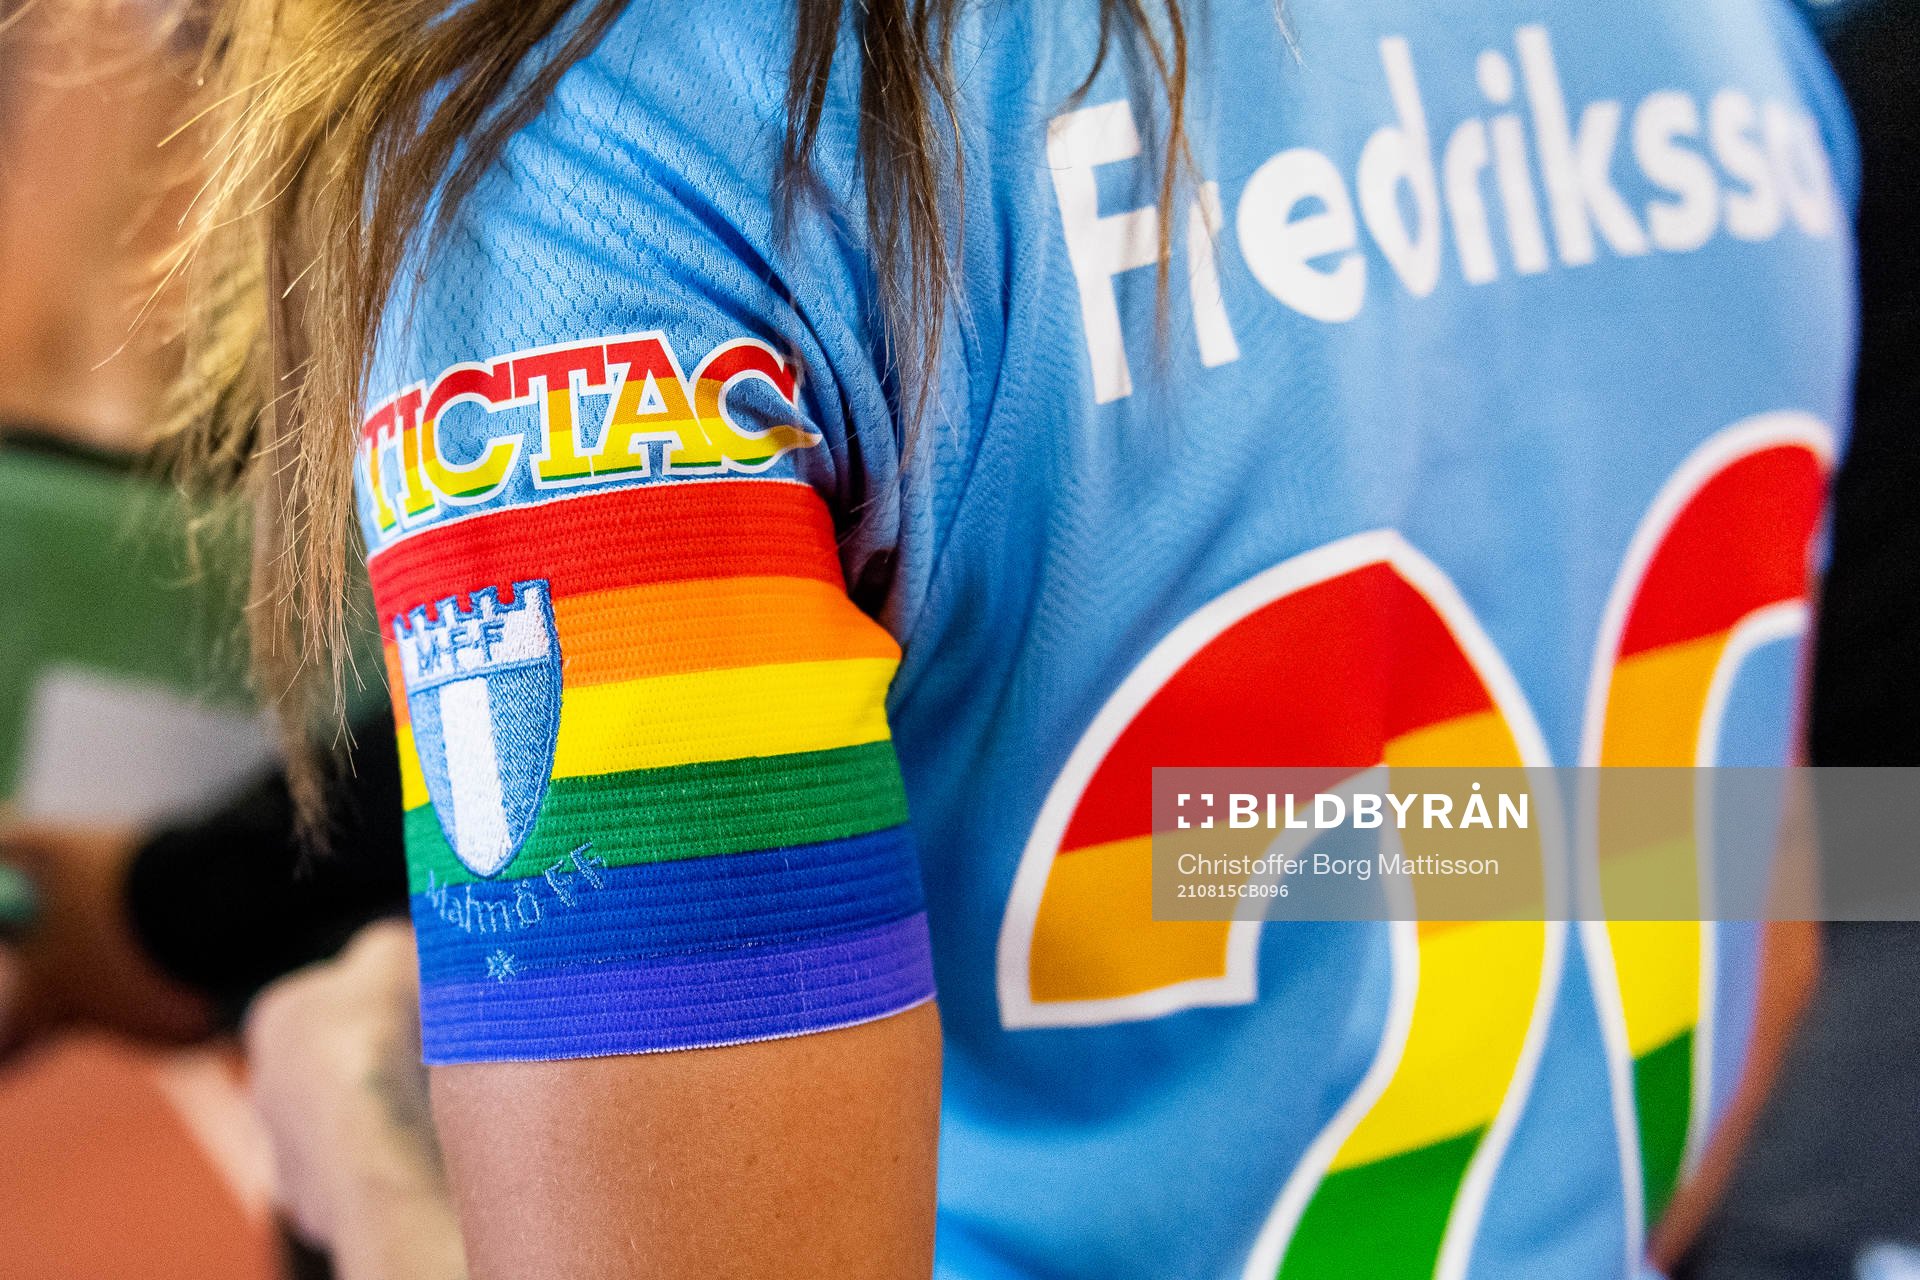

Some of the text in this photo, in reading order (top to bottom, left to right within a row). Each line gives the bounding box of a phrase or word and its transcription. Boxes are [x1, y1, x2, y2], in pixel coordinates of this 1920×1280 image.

[361, 330, 823, 541] TICTAC
[416, 620, 505, 677] MFF
[543, 841, 607, 908] FF
